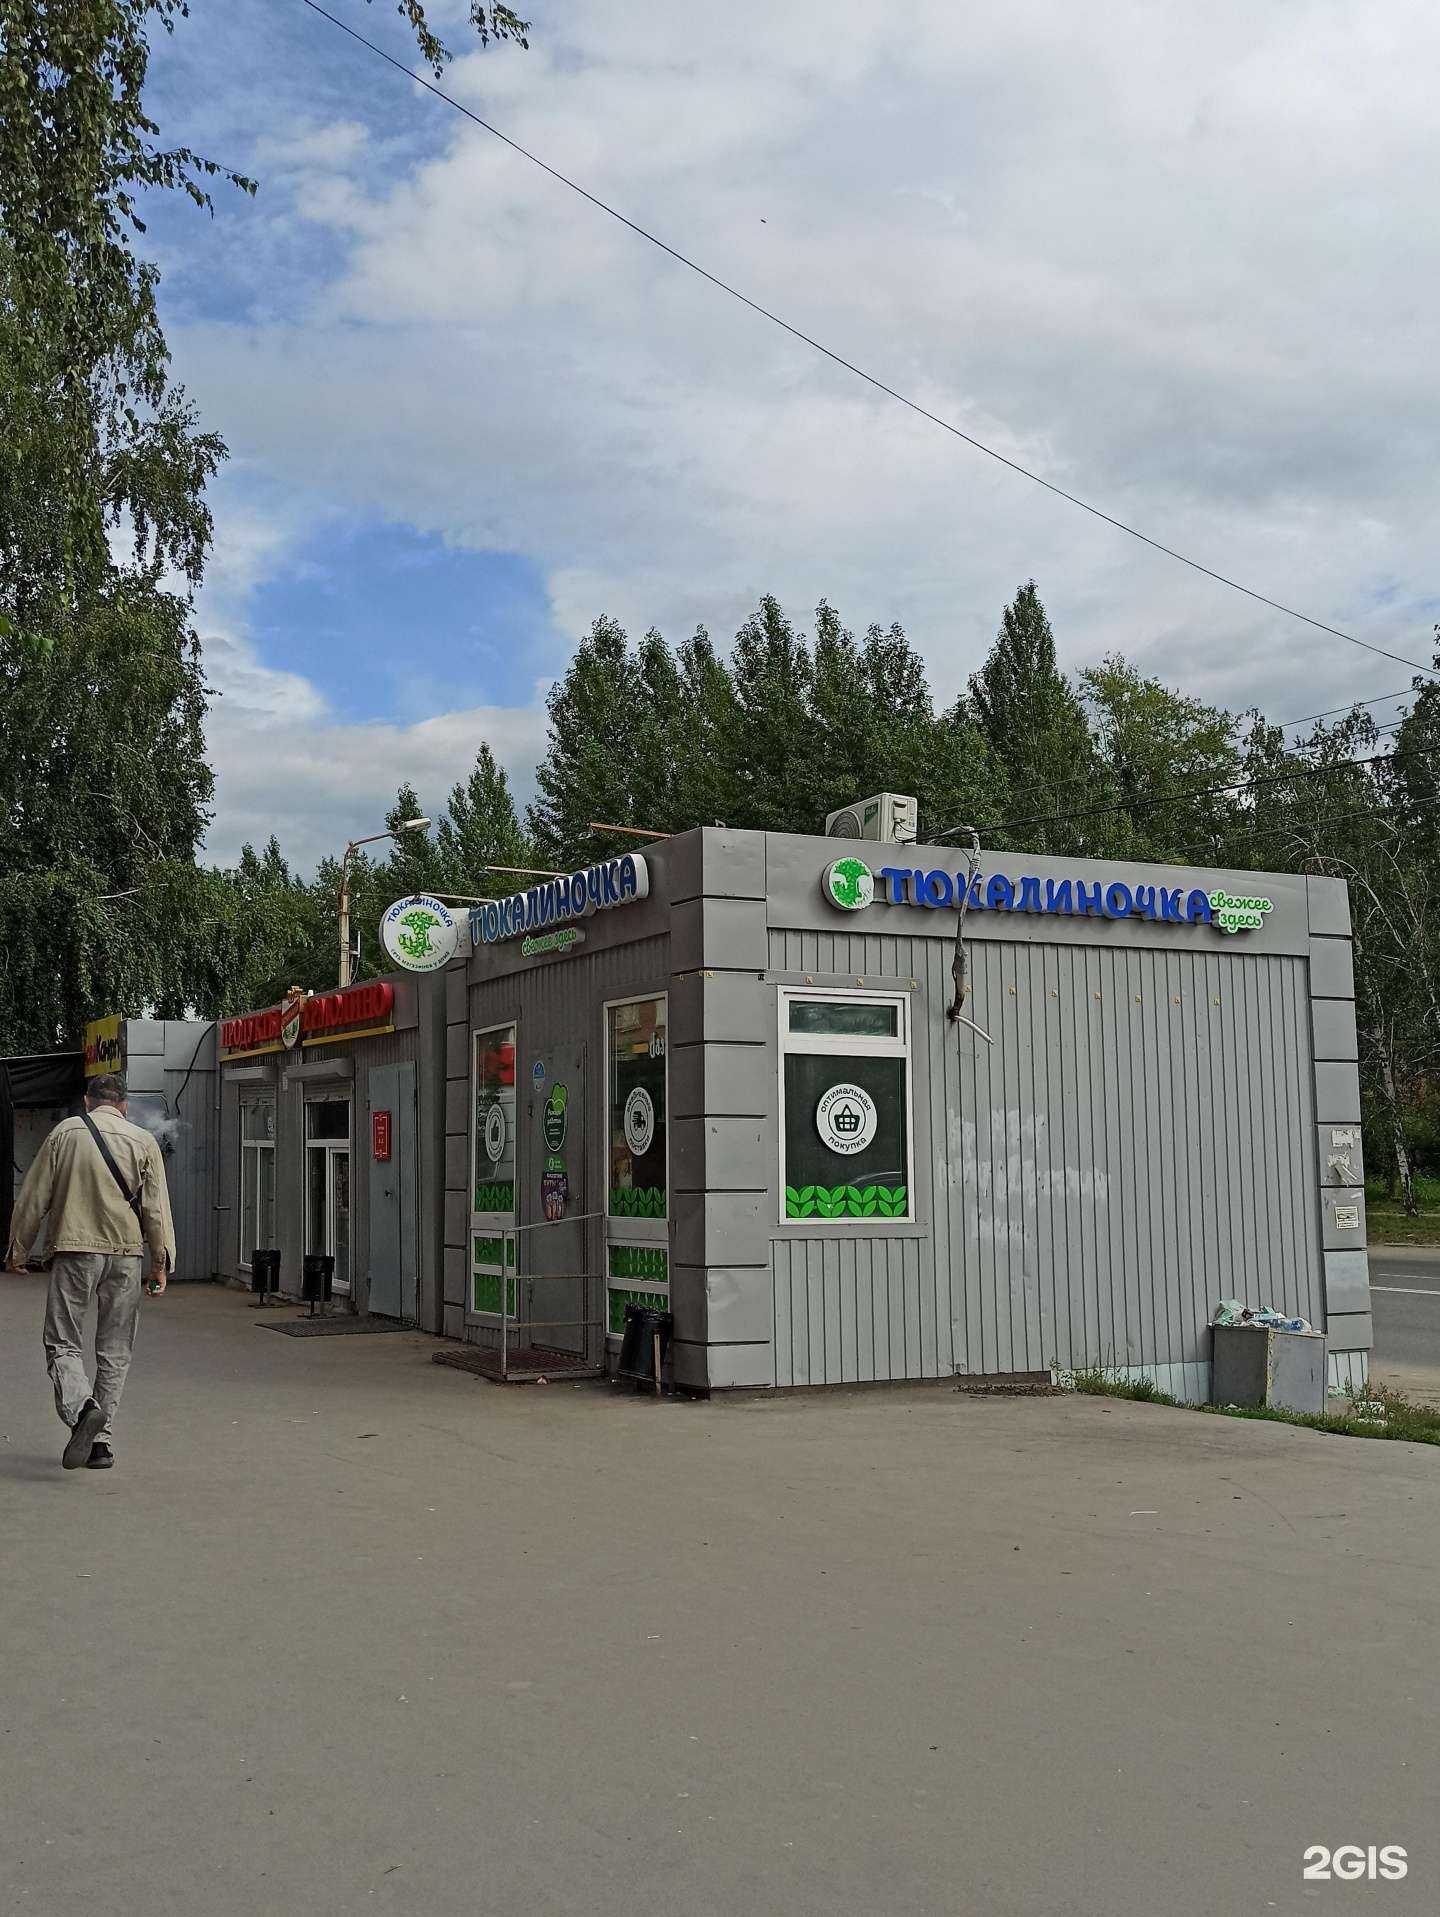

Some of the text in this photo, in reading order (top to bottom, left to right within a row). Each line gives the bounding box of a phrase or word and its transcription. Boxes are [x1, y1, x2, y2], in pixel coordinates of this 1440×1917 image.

[470, 853, 638, 946] ТЮКАЛИНОЧКА
[881, 866, 1212, 924] ТЮКАЛИНОЧКА
[1209, 892, 1272, 911] свежее
[387, 897, 453, 927] ТЮКАНОЧКА
[1219, 912, 1262, 931] здесь
[821, 1088, 871, 1112] оптимальная
[829, 1137, 867, 1151] покупка
